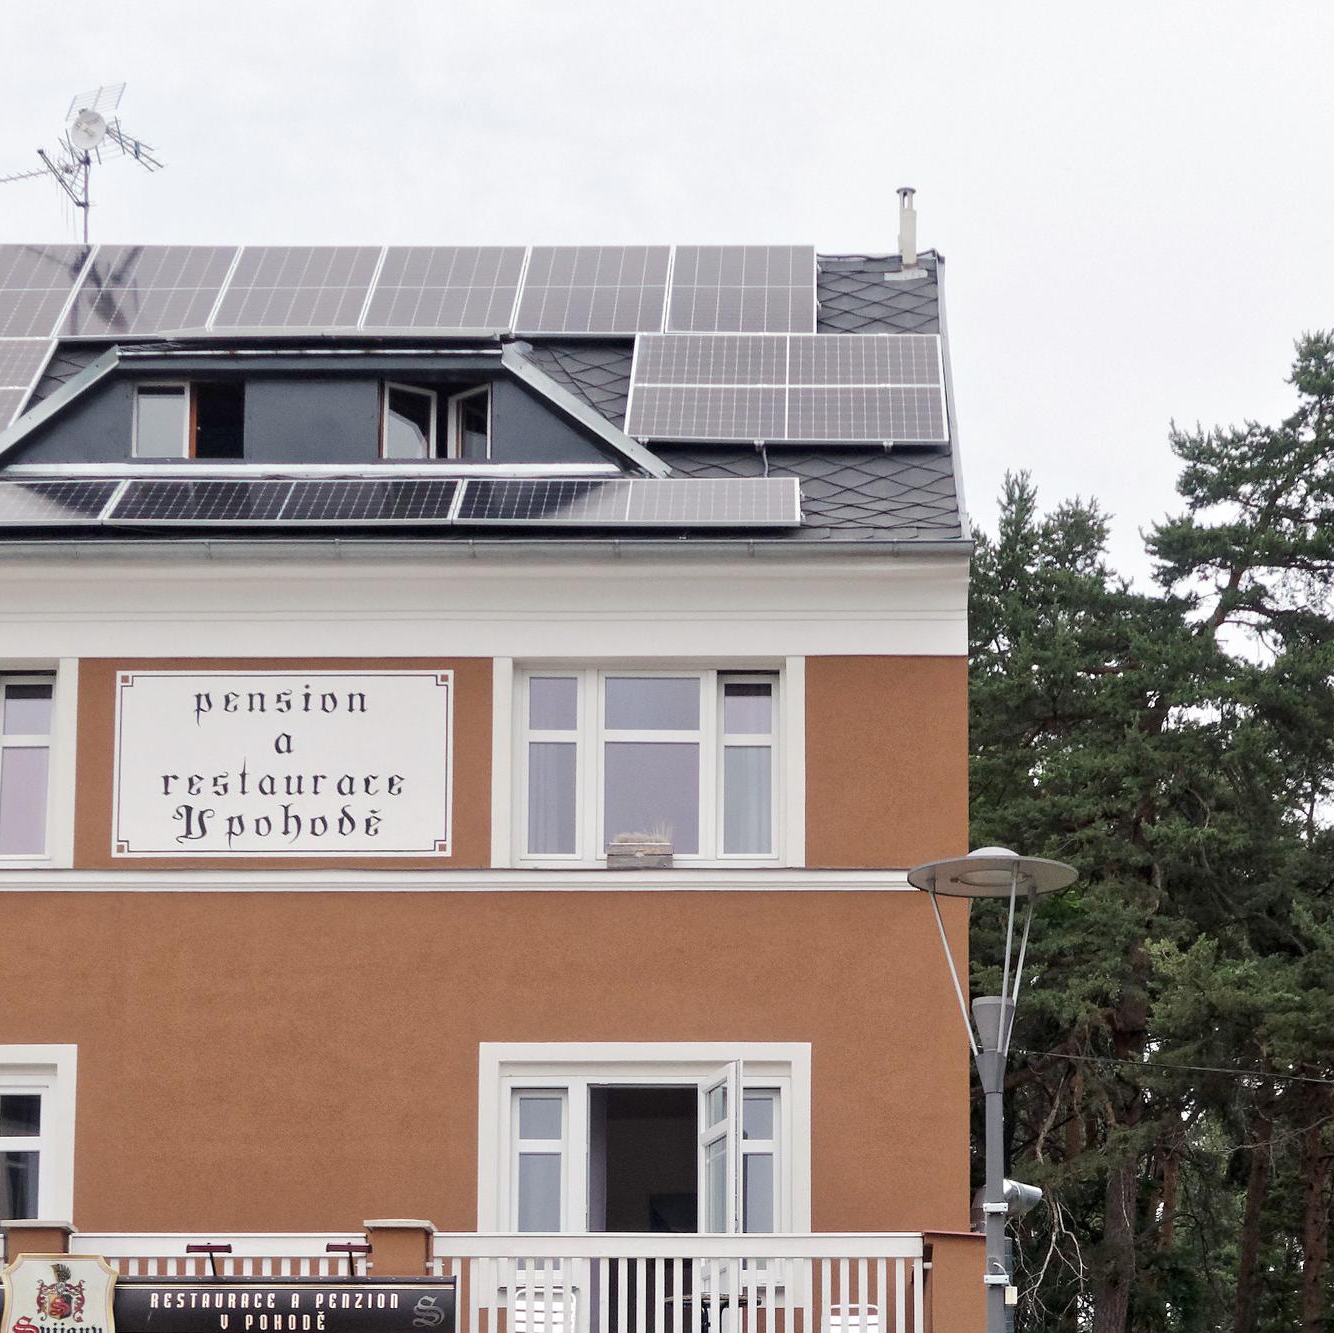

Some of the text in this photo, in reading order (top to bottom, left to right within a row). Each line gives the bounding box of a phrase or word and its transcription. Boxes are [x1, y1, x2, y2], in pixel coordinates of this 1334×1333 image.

[193, 684, 369, 727] pension
[273, 731, 295, 756] a
[160, 757, 406, 797] restaurace
[150, 1292, 400, 1310] RESTAURACE A PENZION
[220, 1311, 326, 1331] V POHODĚ
